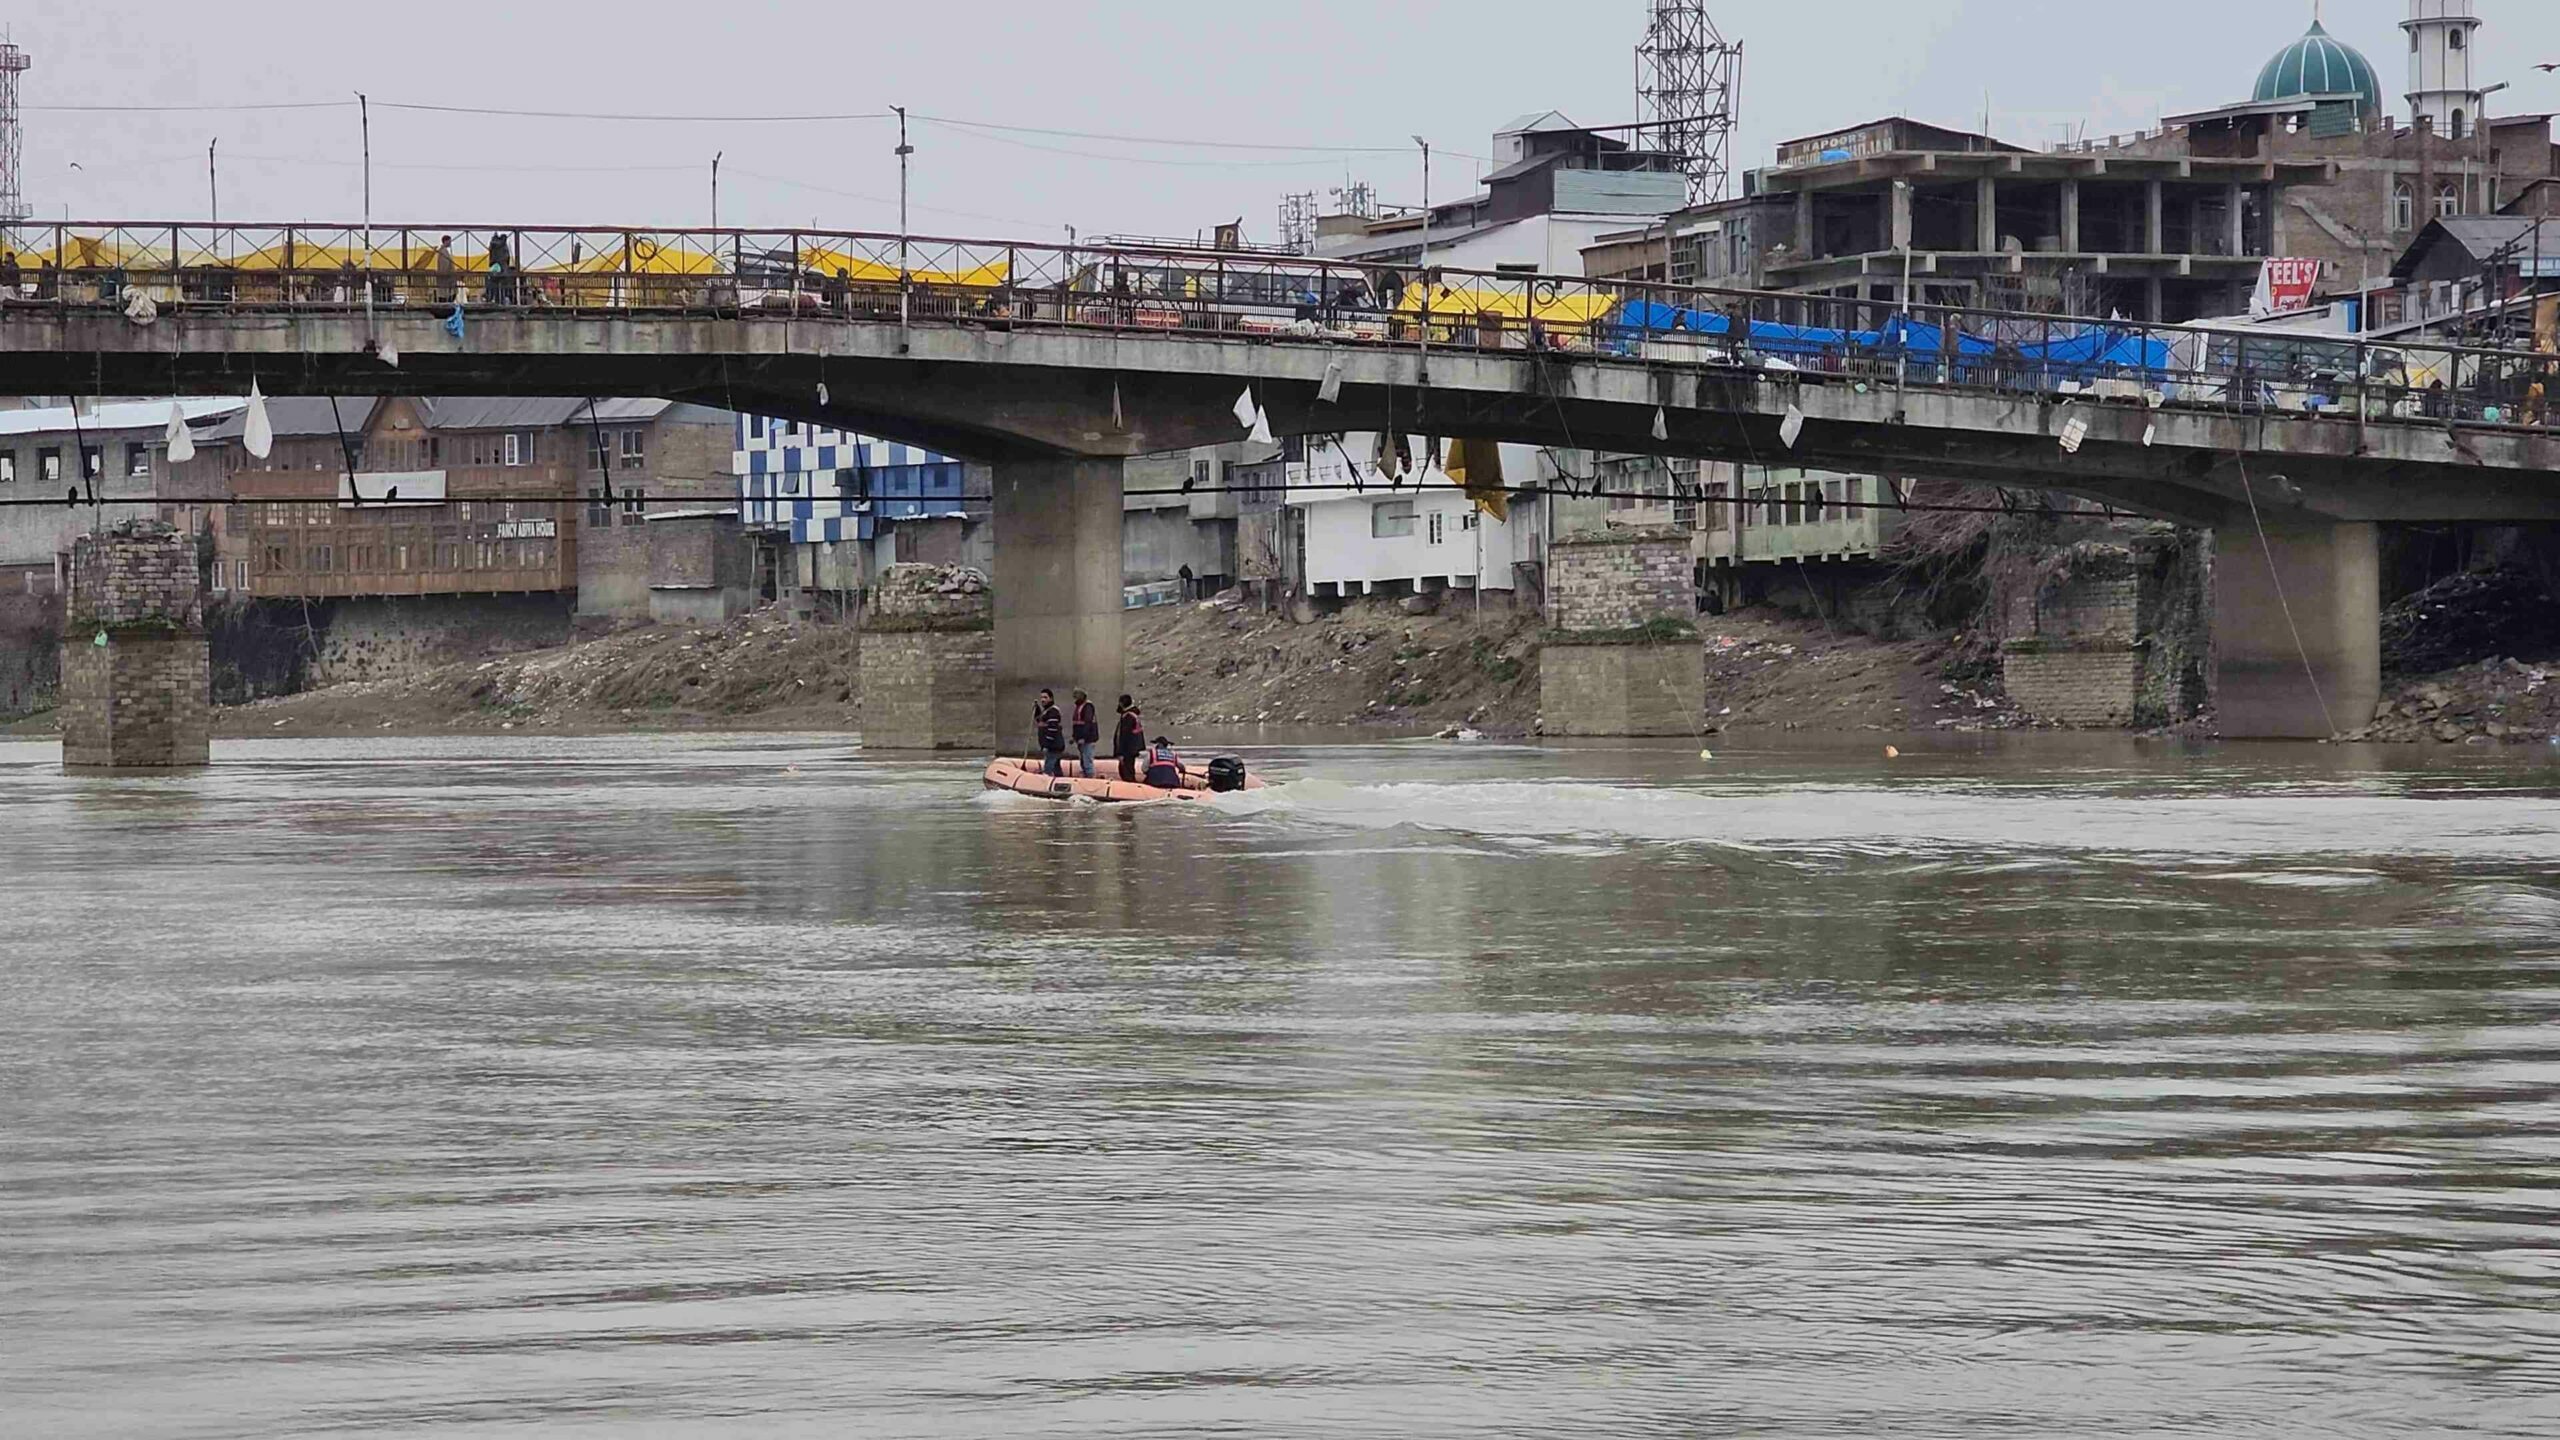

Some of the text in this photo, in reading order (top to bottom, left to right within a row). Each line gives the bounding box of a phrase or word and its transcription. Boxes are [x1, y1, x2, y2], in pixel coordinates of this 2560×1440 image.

[1803, 132, 1867, 153] KAPOORS
[496, 523, 516, 538] FANCY
[536, 522, 555, 537] HOUSE
